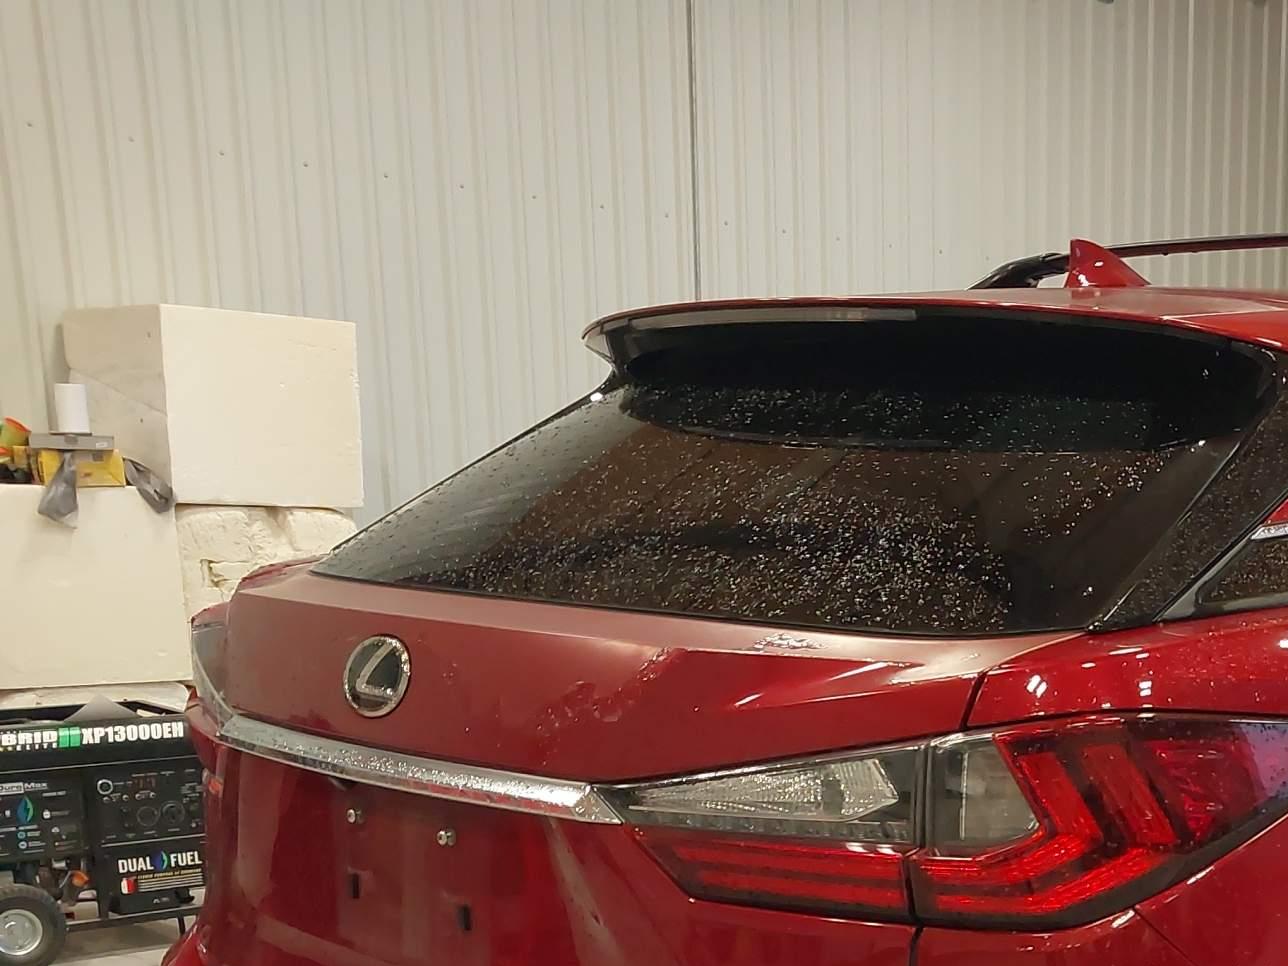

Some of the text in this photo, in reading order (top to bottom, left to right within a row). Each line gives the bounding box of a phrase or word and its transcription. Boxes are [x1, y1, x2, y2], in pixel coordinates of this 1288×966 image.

[81, 722, 184, 745] XP13000EH
[117, 851, 203, 873] DUAL FUEL
